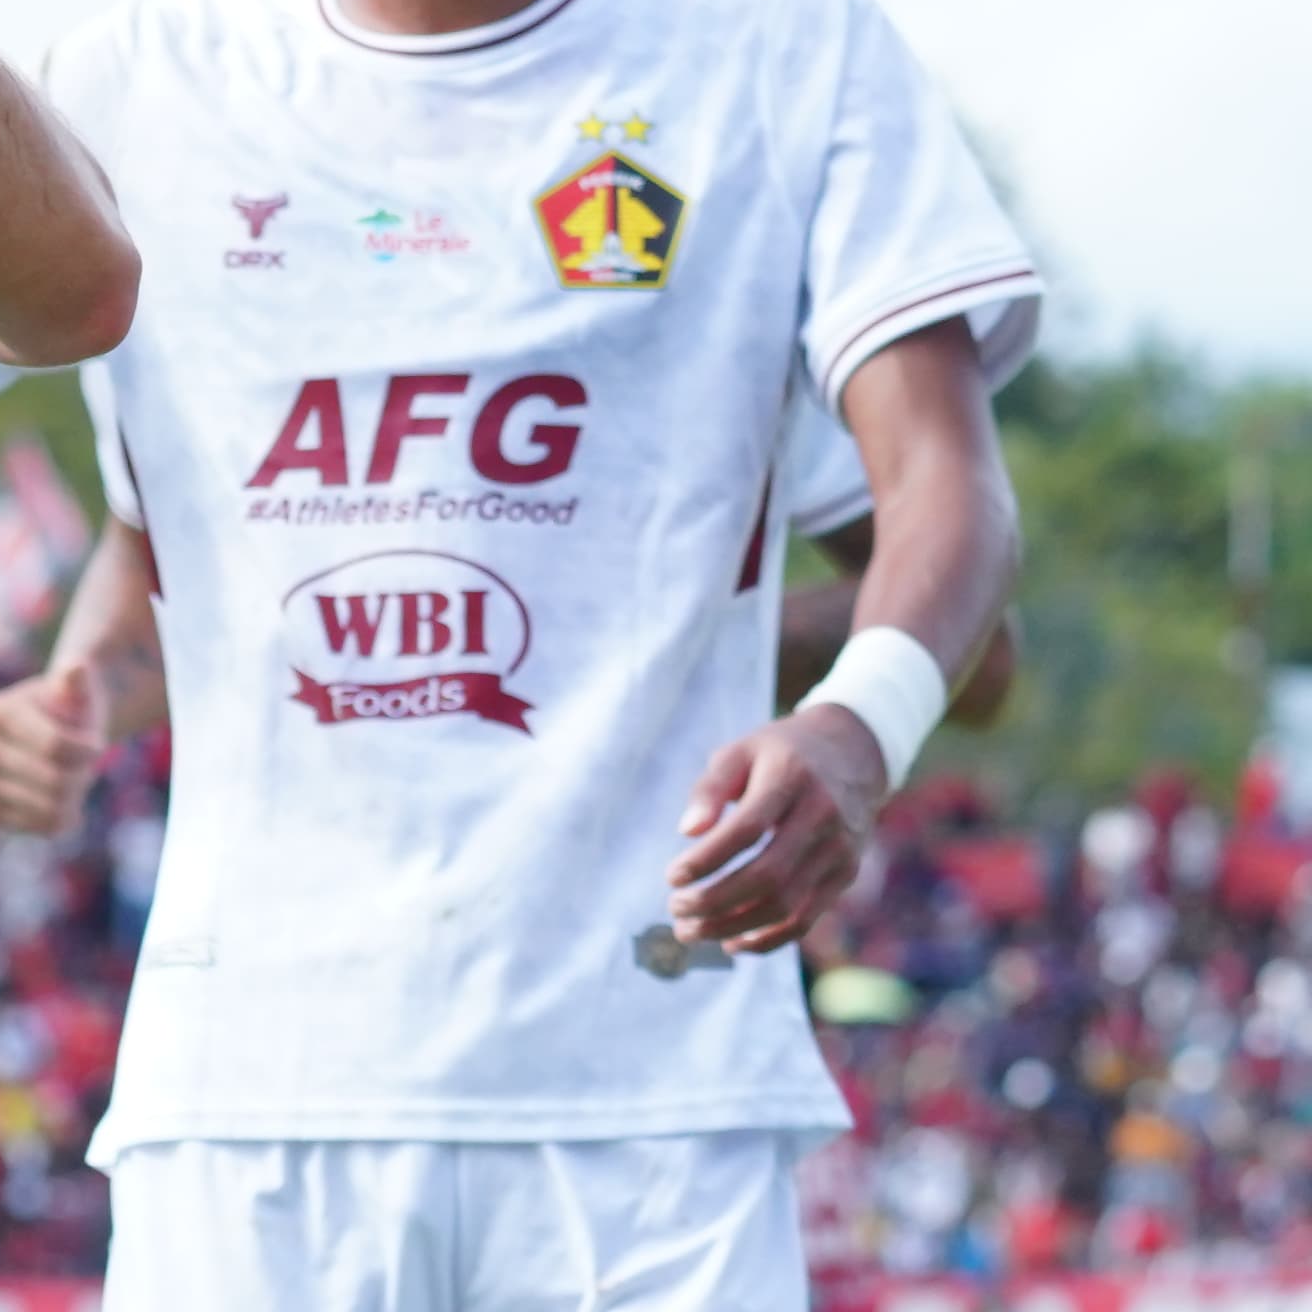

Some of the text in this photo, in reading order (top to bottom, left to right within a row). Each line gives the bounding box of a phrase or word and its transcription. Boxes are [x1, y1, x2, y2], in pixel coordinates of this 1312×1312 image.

[244, 373, 589, 489] AFG
[245, 491, 580, 526] #AthletesForGood
[315, 590, 489, 658] WBI
[326, 679, 467, 721] Foods
